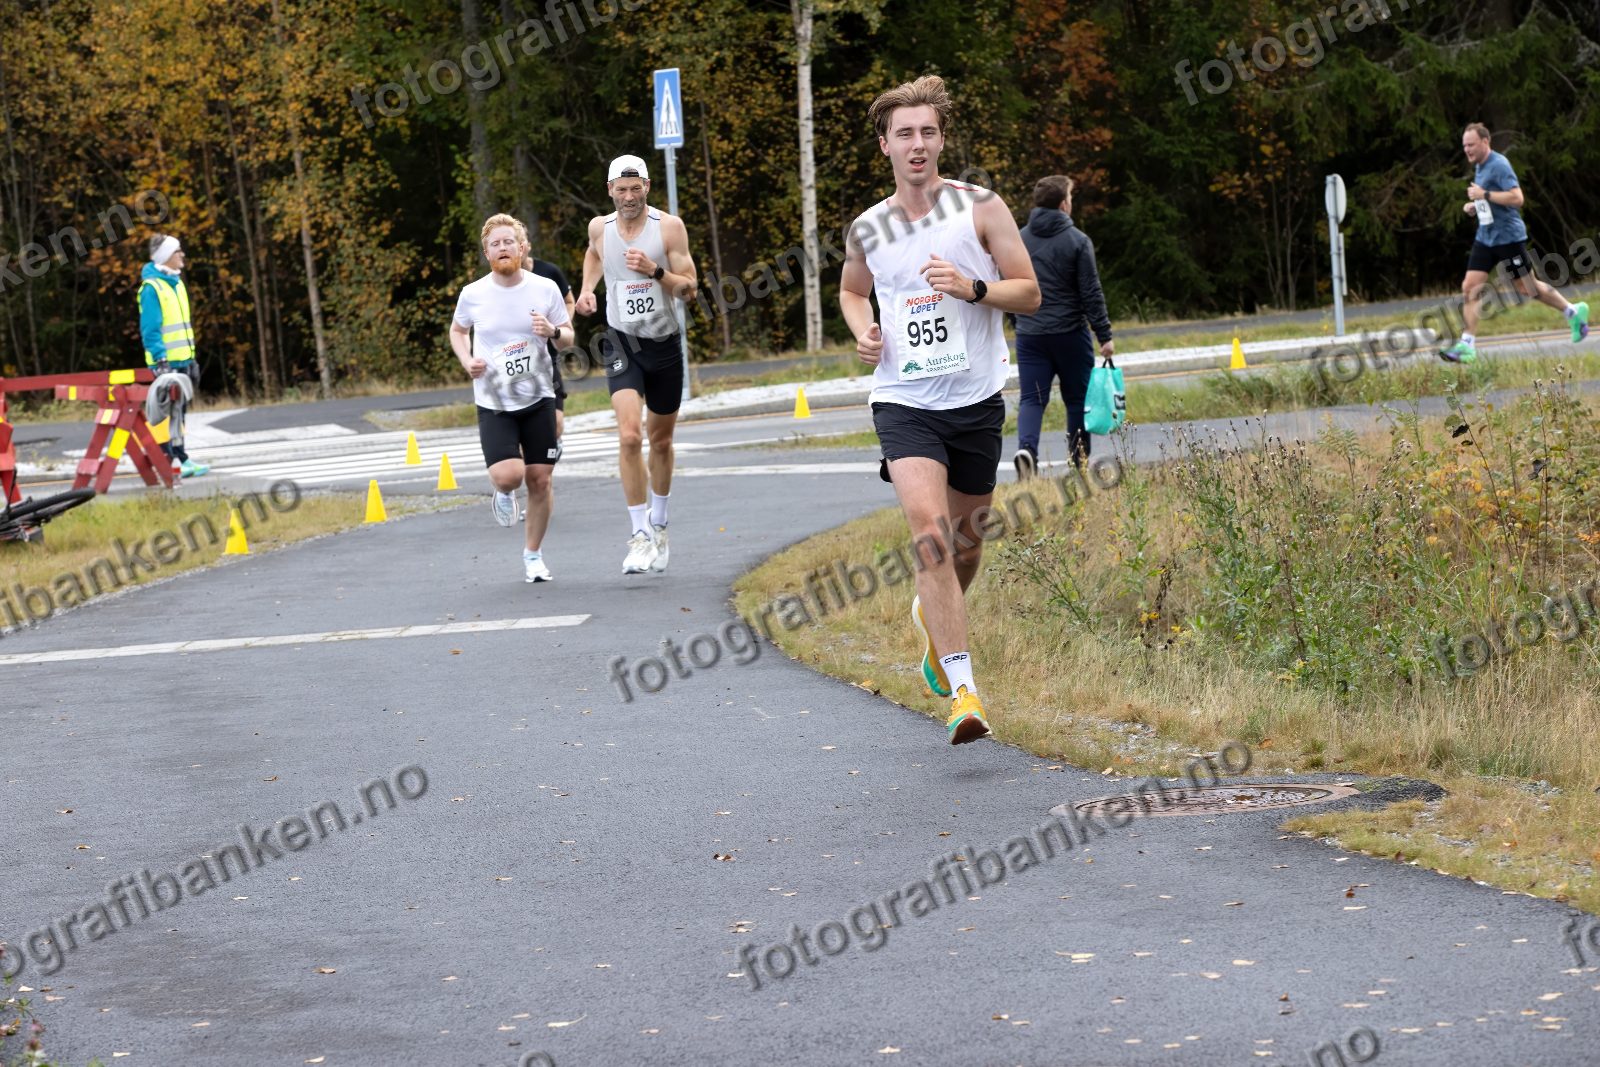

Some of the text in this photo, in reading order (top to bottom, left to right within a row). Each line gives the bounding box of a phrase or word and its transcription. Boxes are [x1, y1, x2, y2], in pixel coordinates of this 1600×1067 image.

[626, 282, 653, 290] NORGES
[626, 296, 655, 315] 382
[905, 293, 944, 307] NORGES
[911, 302, 938, 314] LØPET
[907, 316, 948, 347] 955
[505, 355, 531, 376] 857
[925, 352, 966, 367] Aurskog
